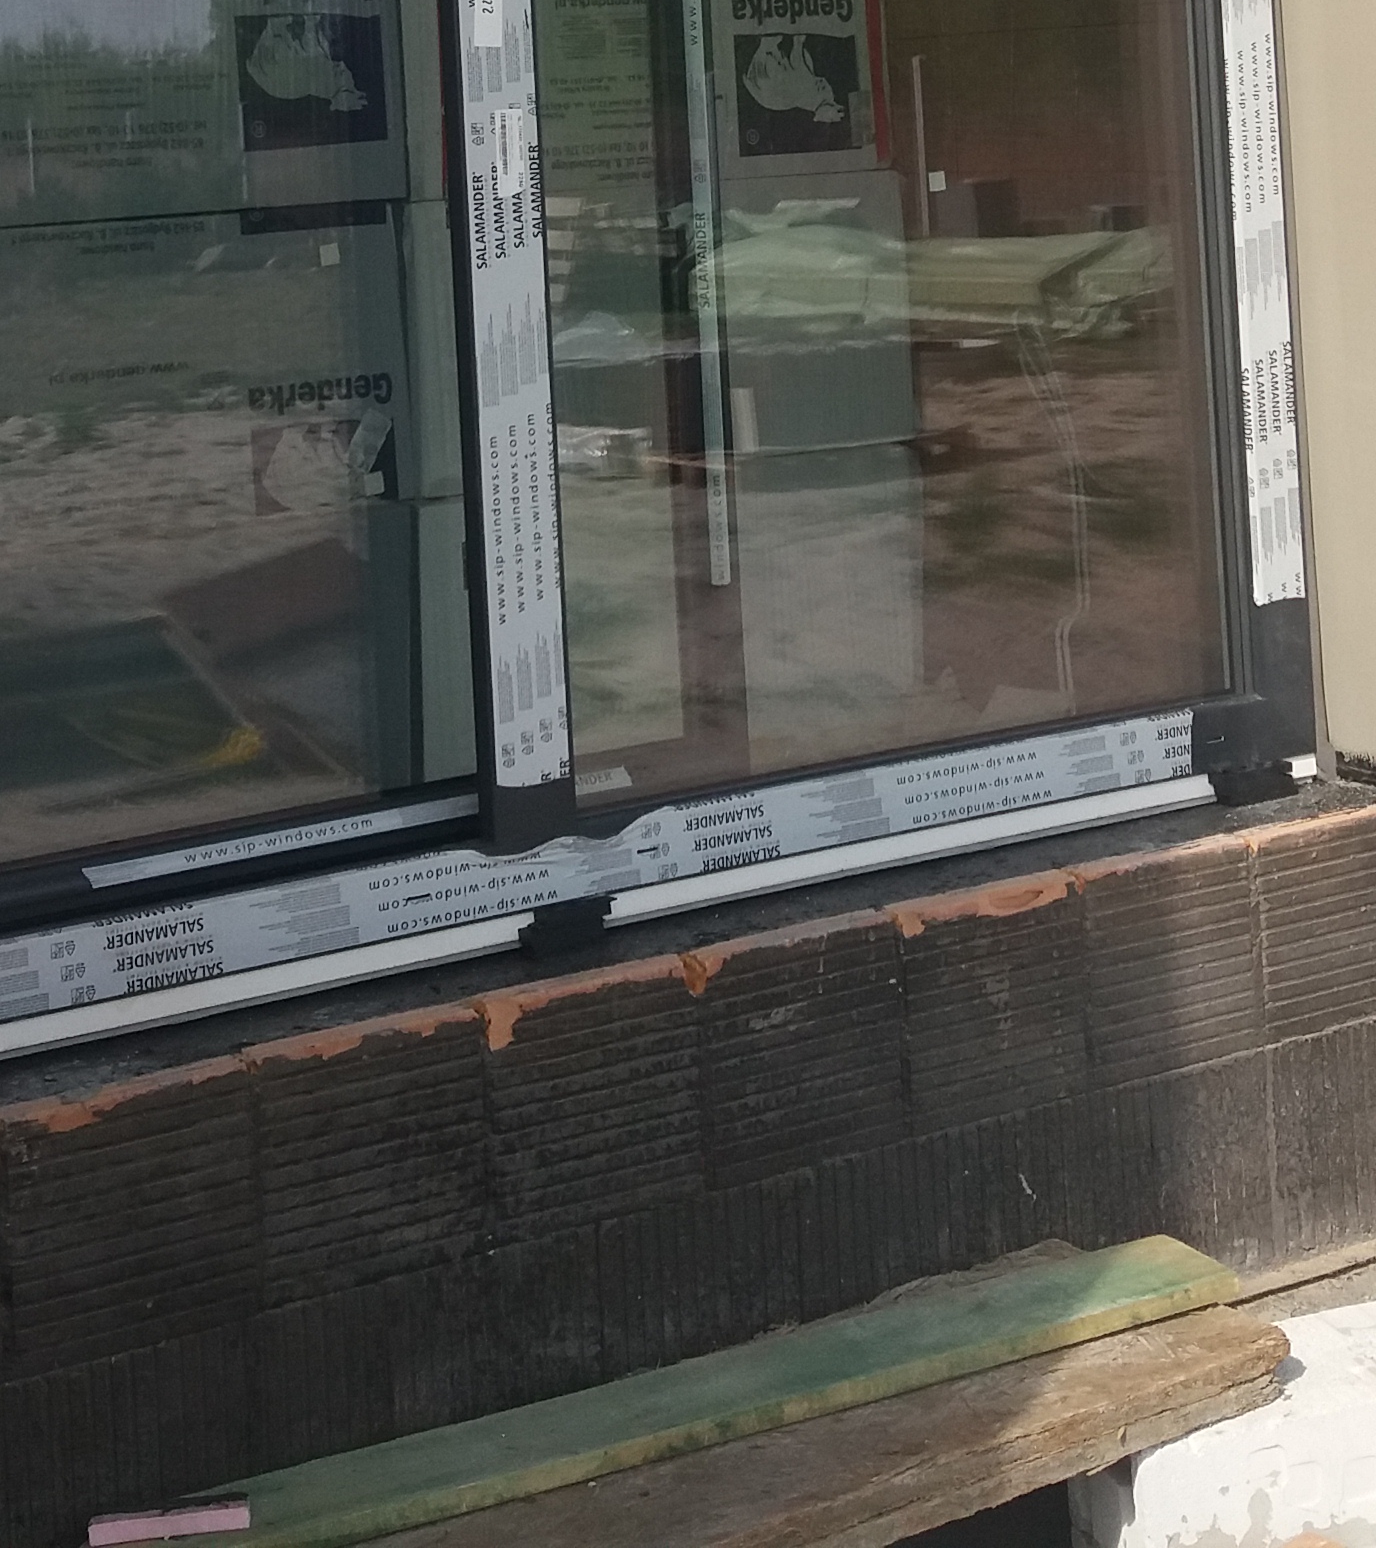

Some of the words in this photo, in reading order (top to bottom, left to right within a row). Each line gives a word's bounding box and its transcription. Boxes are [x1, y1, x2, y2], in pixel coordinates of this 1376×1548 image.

[1237, 50, 1252, 213] www.sip-windows.com
[1251, 41, 1266, 204] www.sip-windows.com
[1264, 33, 1279, 196] www.sip-windows.com
[472, 171, 488, 270] SALAMANDER
[529, 141, 544, 239] SALAMANDER
[694, 212, 711, 309] SALAMANDER
[248, 372, 392, 415] Genderka
[1255, 359, 1268, 444] SALAMANDER
[1268, 350, 1281, 436] SALAMANDER
[1282, 340, 1295, 425] SALAMANDER
[490, 435, 507, 626] www.sip-windows.com
[508, 424, 526, 613] www.sip-windows.com
[527, 413, 543, 601] www.sip-windows.com
[897, 751, 1037, 785] www.sip-windows.com
[904, 770, 1045, 805] www.sip-windows.com
[683, 804, 765, 832] SALAMANDER
[692, 825, 773, 852] SALAMANDER
[912, 789, 1052, 825] www.sip-windows.com
[184, 817, 374, 864] www.sip-windows.com
[702, 845, 781, 872] SALAMANDER
[103, 917, 204, 951] SALAMANDER
[387, 889, 558, 935] www.sip-windows.com
[113, 939, 214, 973] SALAMANDER
[126, 960, 224, 994] SALAMANDER
